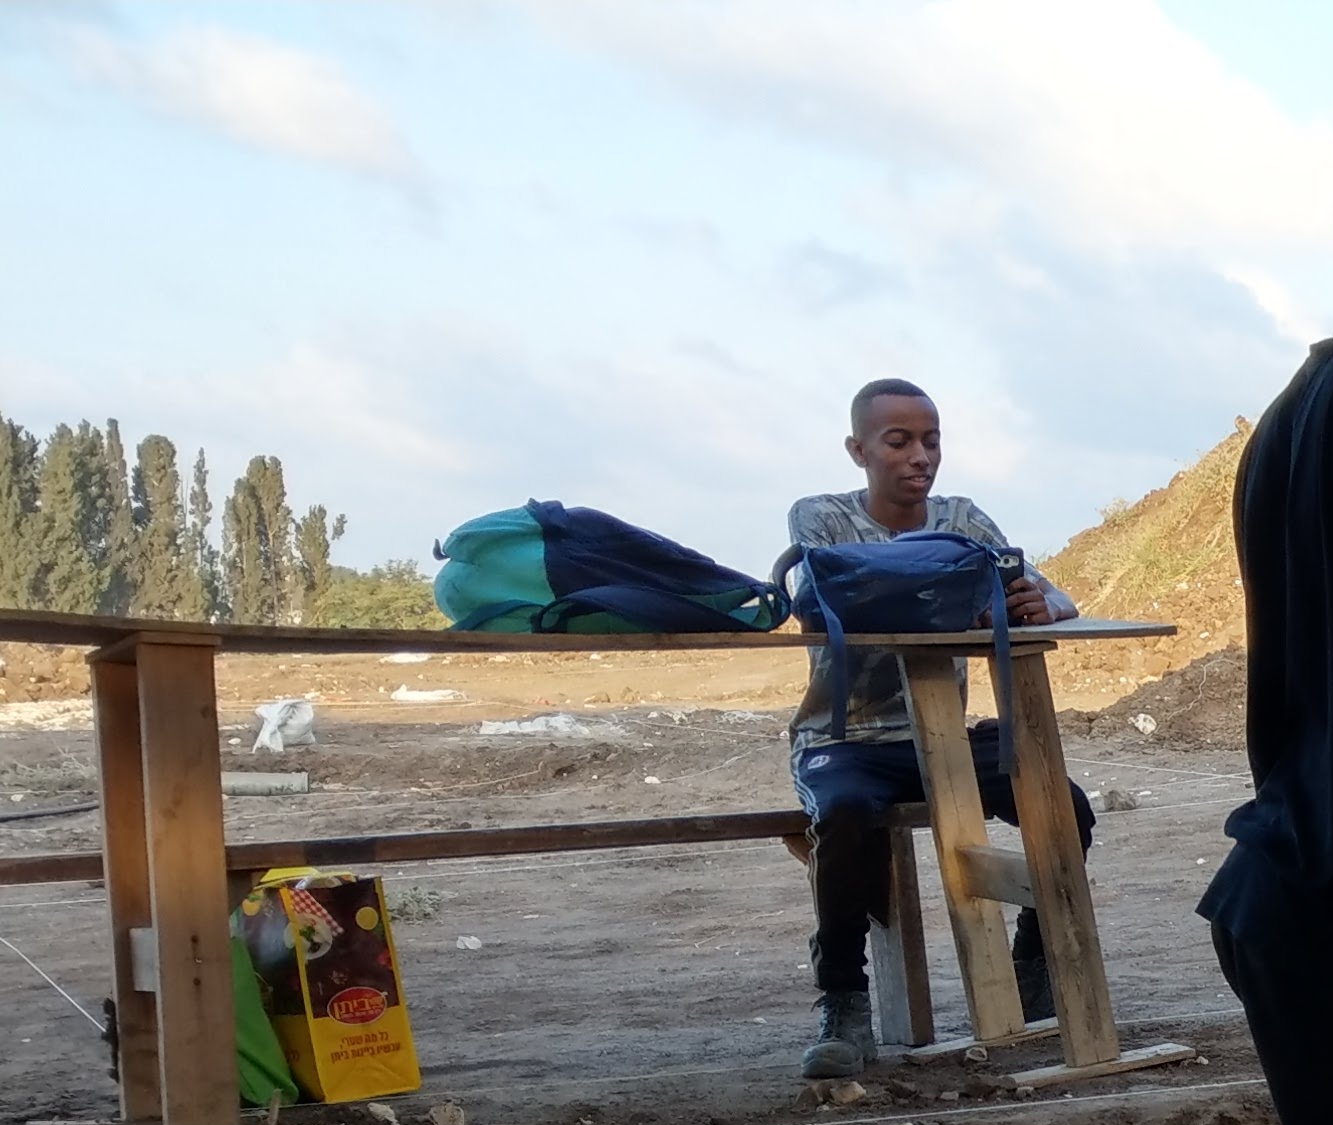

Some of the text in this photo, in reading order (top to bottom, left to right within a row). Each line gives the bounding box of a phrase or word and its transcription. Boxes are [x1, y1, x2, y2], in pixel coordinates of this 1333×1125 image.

[333, 998, 370, 1020] ביתן
[365, 1033, 378, 1043] מה
[378, 1031, 389, 1041] כל
[331, 1050, 350, 1064] ביתן
